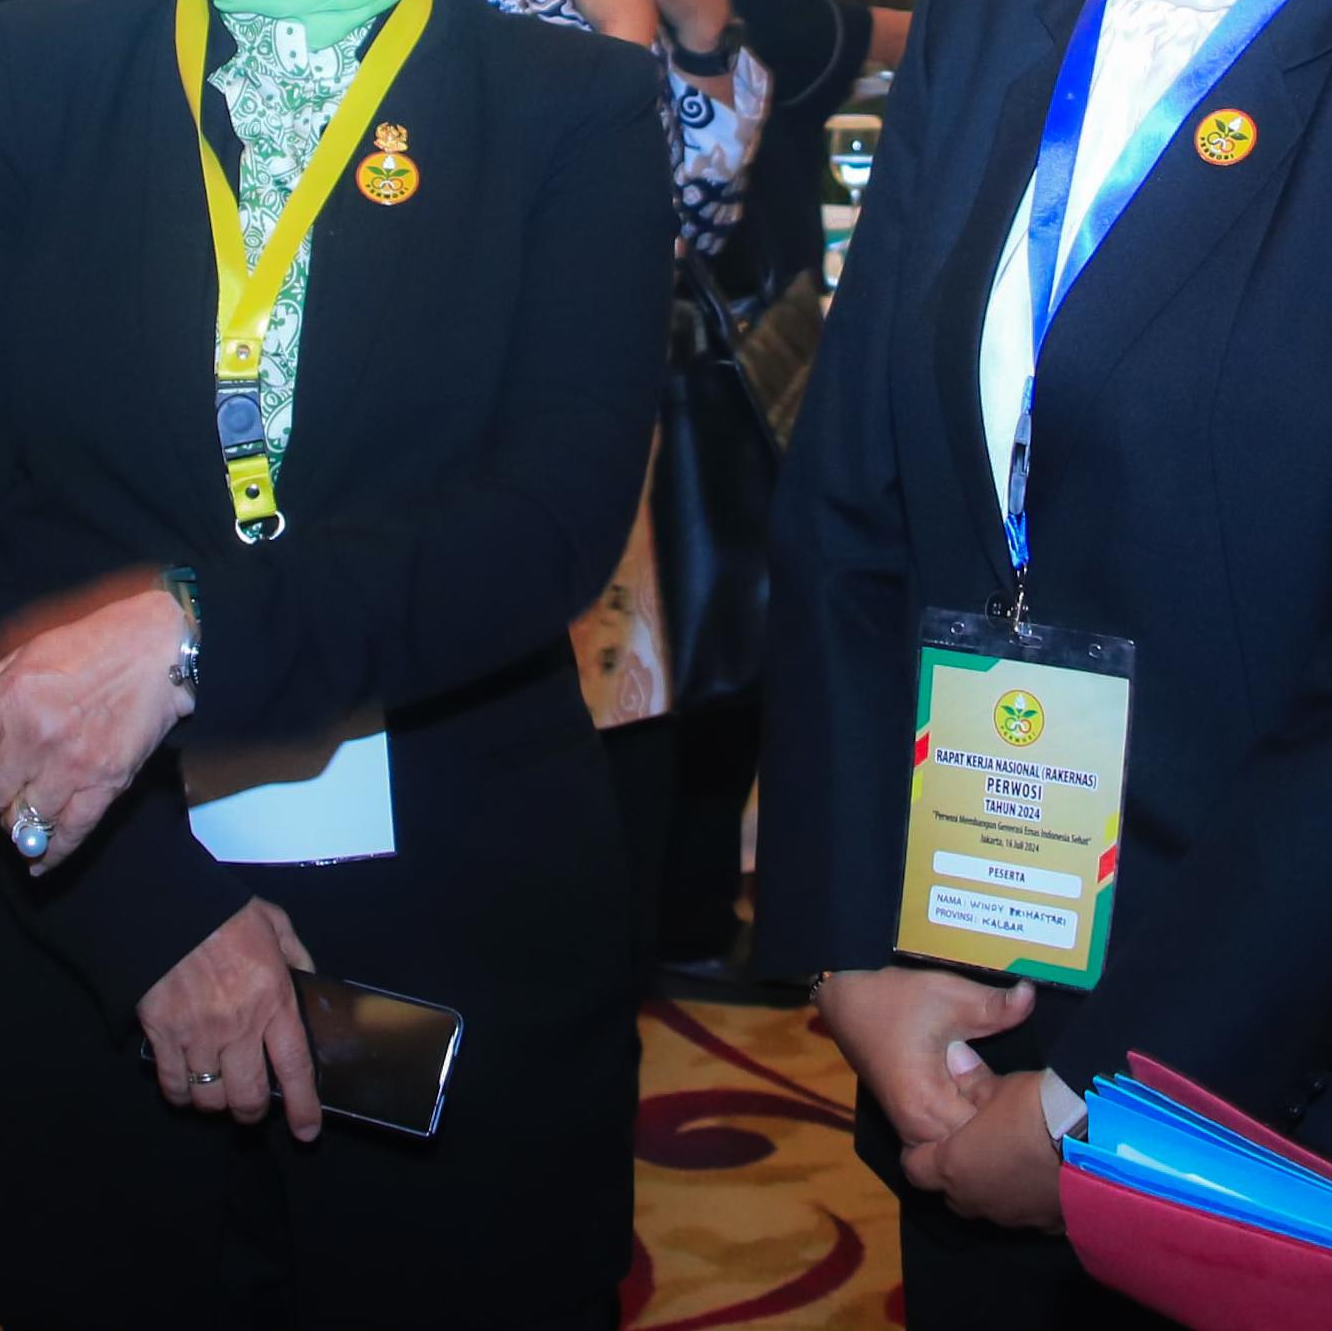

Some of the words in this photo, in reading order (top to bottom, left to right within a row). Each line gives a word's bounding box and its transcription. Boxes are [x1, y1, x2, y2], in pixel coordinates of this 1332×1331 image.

[936, 749, 965, 766] RAPAT
[966, 754, 994, 771] KERJA
[995, 759, 1040, 779] NASIONAL
[1041, 768, 1098, 789] (RAKERNAS)
[987, 777, 1043, 801] PERWOSI
[986, 799, 1017, 816] TAHUN
[1018, 804, 1041, 820] 2024
[988, 866, 1026, 883] PESERTA
[970, 900, 1004, 913] WINDY
[982, 917, 1024, 932] KALBAR
